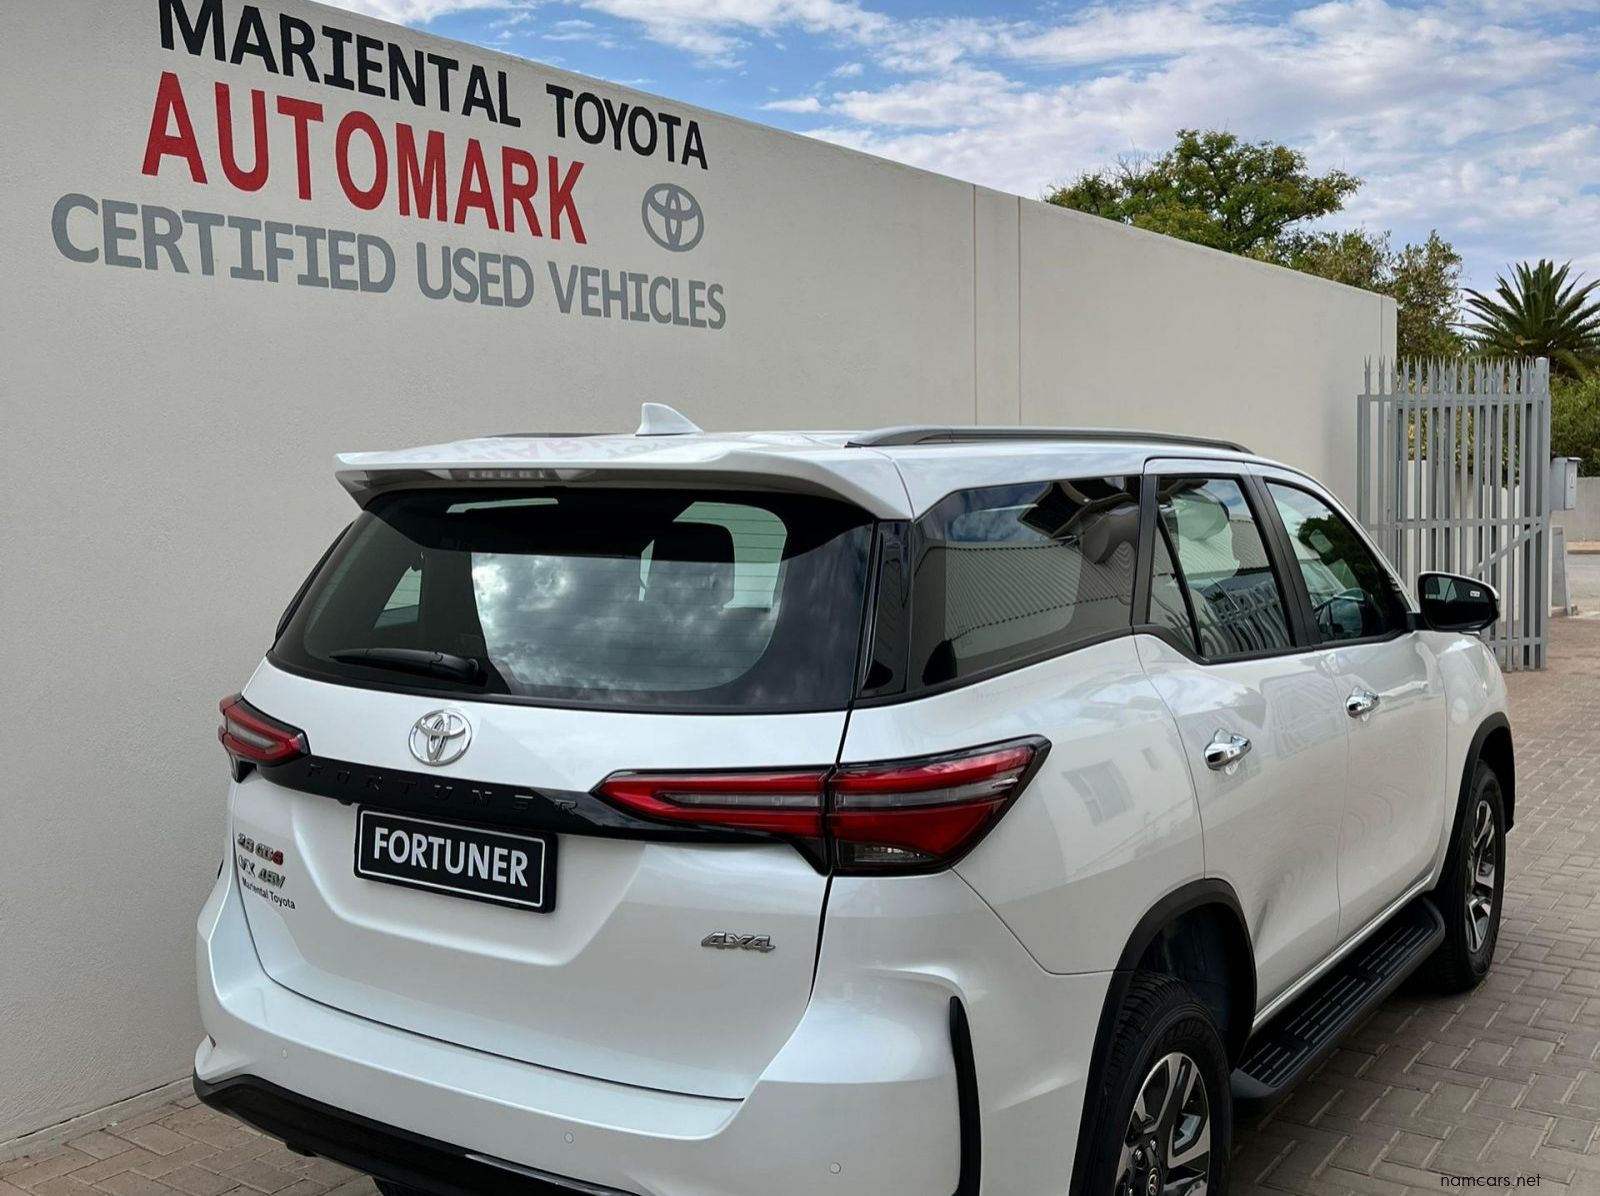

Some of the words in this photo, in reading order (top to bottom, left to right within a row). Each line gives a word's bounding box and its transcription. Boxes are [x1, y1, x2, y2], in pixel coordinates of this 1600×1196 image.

[159, 0, 521, 128] MARIENTAL
[546, 83, 708, 170] TOYOTA
[142, 71, 588, 244] AUTOMARK
[51, 193, 396, 294] CERTIFIED
[416, 242, 535, 308] USED
[548, 261, 726, 330] VEHICLES
[269, 890, 296, 909] Toyota
[373, 827, 529, 888] FORTUNER
